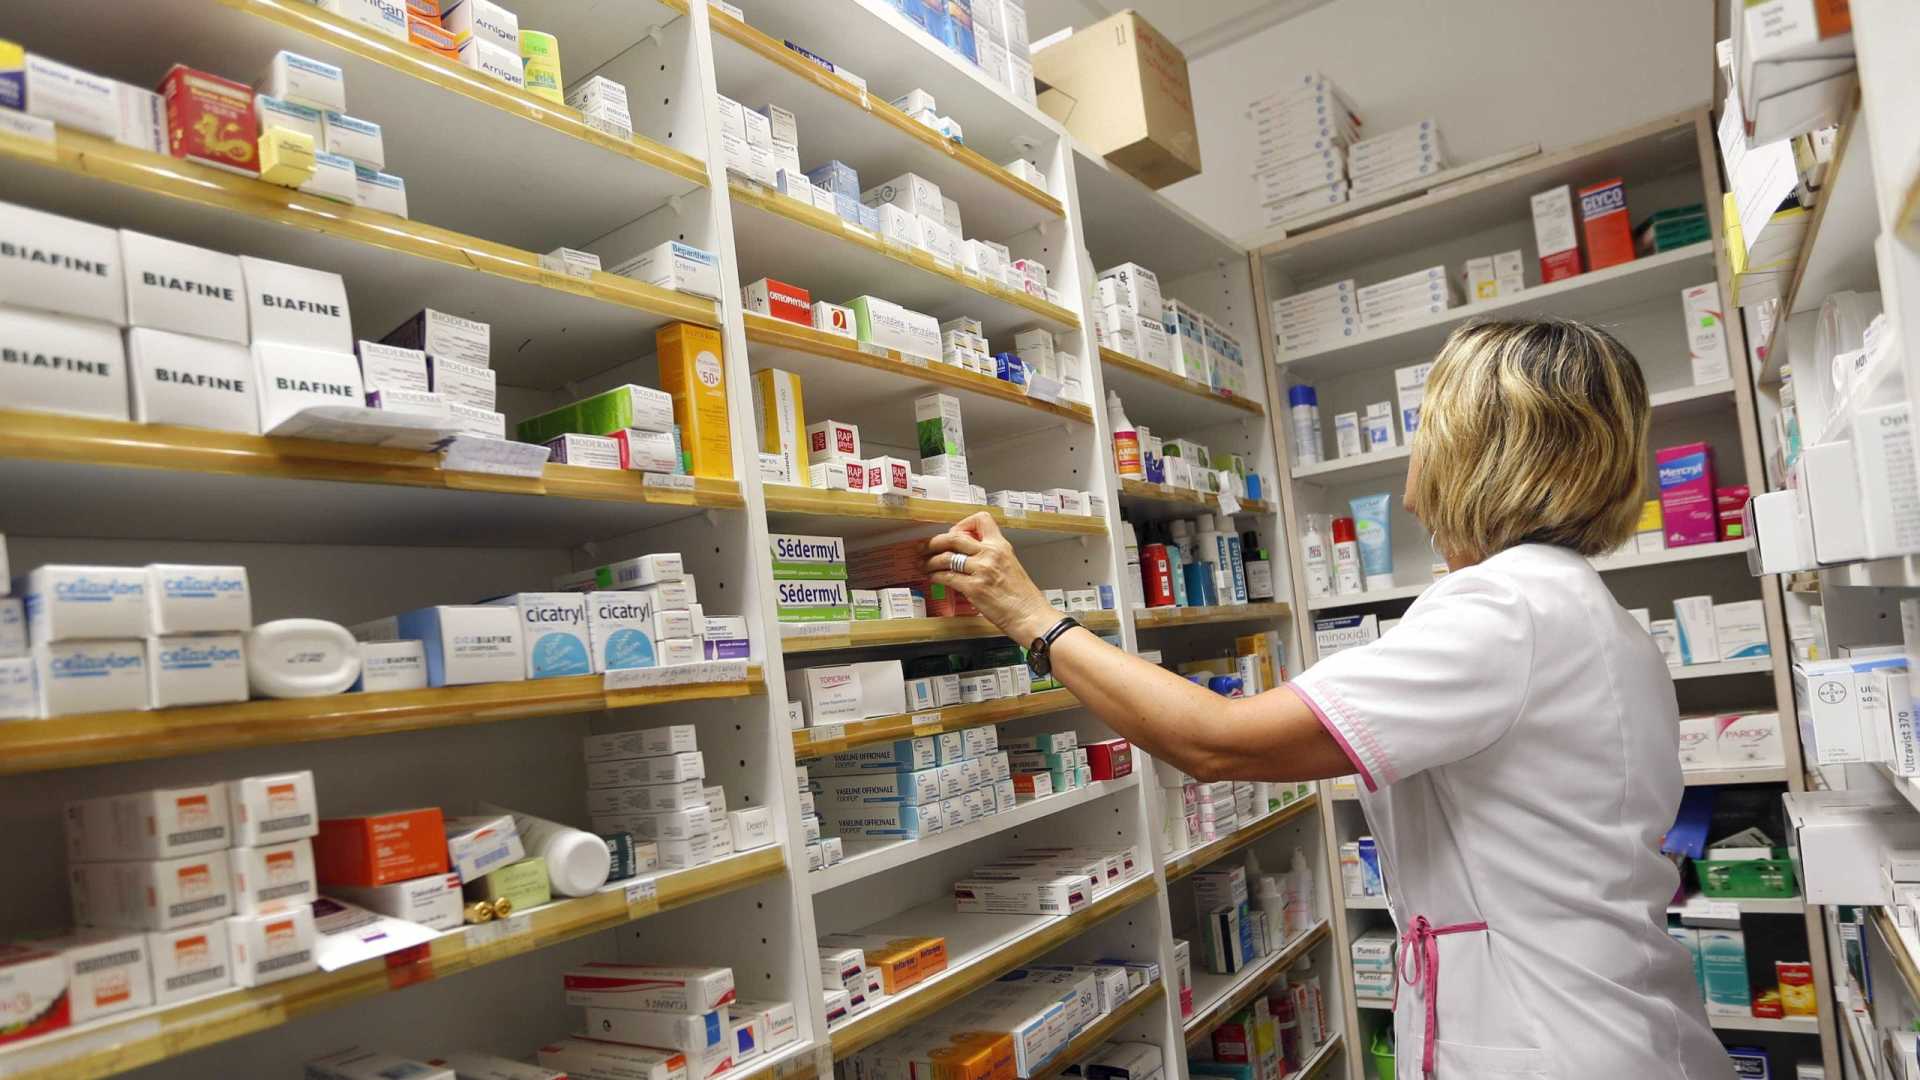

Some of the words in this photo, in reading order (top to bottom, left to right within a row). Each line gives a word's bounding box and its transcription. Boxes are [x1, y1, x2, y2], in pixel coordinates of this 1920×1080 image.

[476, 18, 516, 41] Arnigel
[482, 62, 523, 84] Arnigel
[1, 242, 108, 277] BIAFINE
[142, 271, 235, 302] BIAFINE
[262, 293, 341, 318] BIAFINE
[1, 349, 110, 377] BIAFINE
[155, 368, 245, 393] BIAFINE
[276, 377, 354, 398] BIAFINE
[837, 430, 853, 442] RAP
[847, 465, 863, 477] RAP
[892, 465, 906, 477] RAP
[1659, 463, 1703, 479] Mercryl
[777, 538, 840, 563] Sédermyl
[779, 584, 842, 607] Sédermyl
[526, 604, 585, 626] cicatryl
[599, 601, 650, 627] cicatryl
[1318, 627, 1370, 641] minoxidil
[1898, 711, 1911, 729] 370
